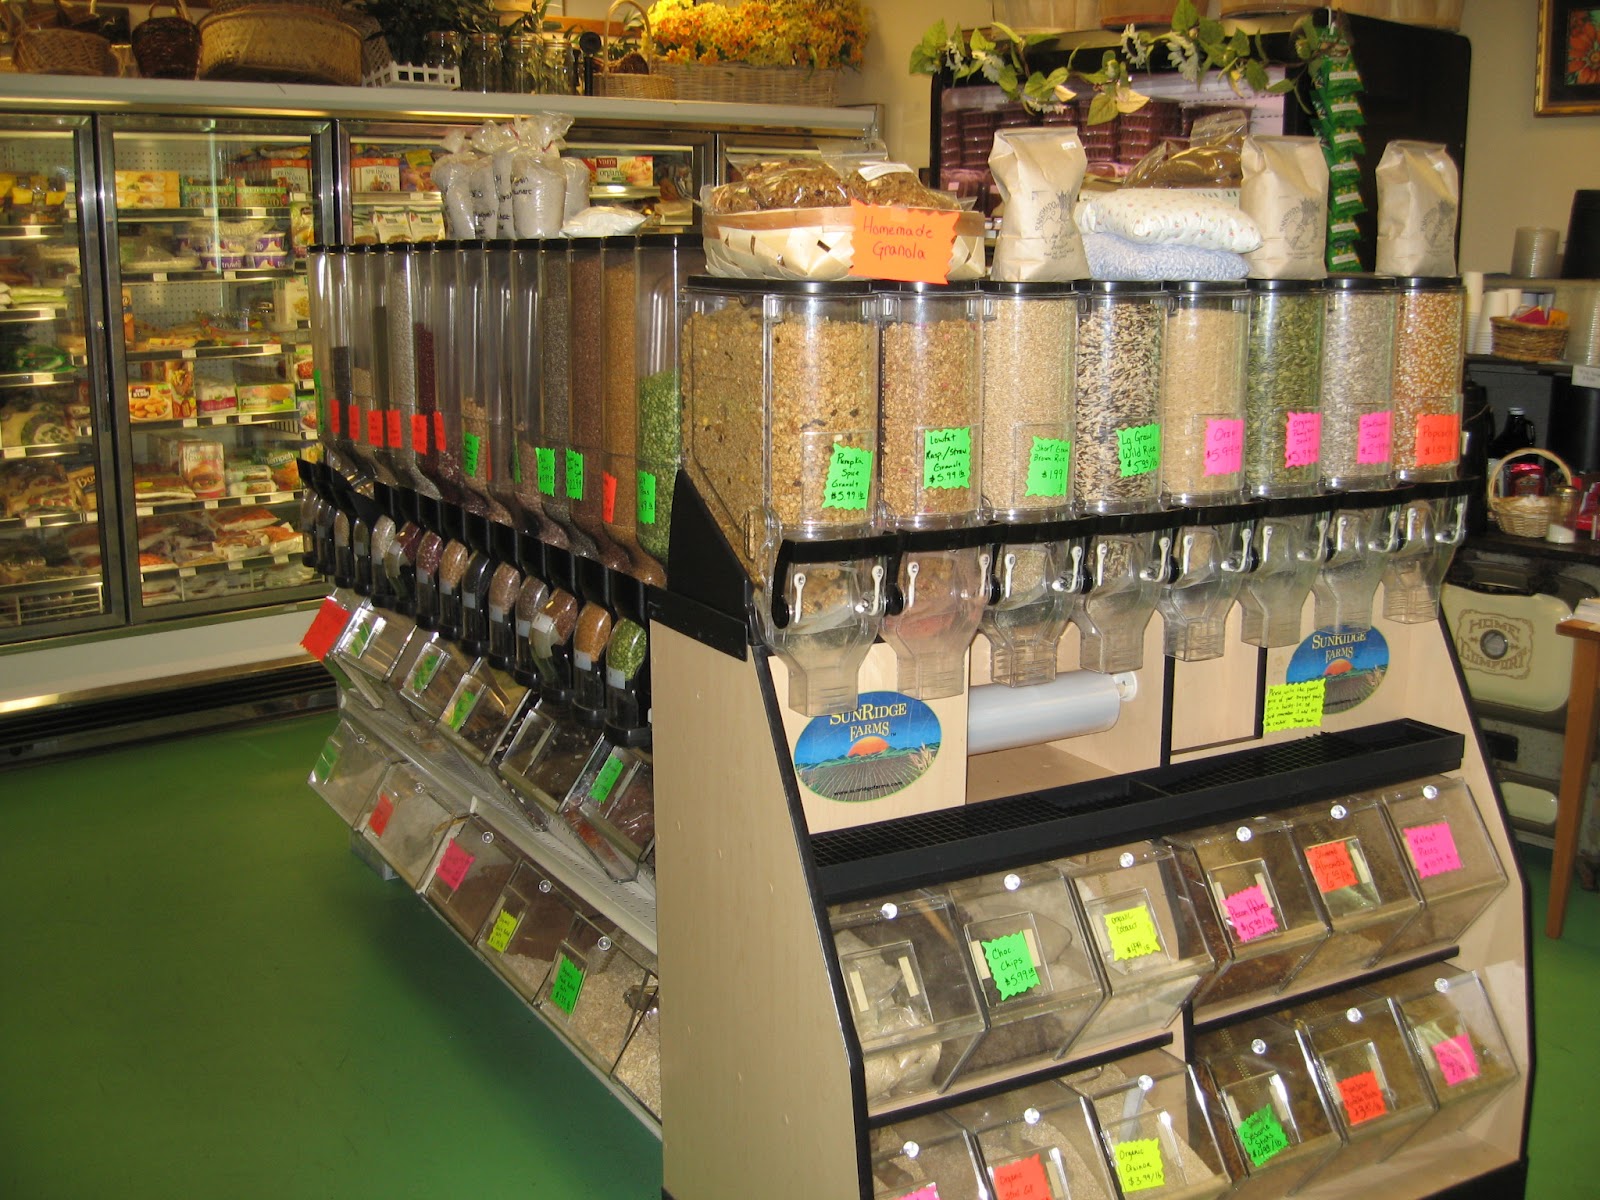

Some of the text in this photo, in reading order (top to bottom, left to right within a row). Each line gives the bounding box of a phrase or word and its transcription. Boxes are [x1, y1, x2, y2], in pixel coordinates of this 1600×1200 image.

[863, 216, 933, 239] Homemade
[873, 241, 926, 261] Granola
[930, 432, 956, 445] Lowfat
[1424, 425, 1452, 441] Popcorn
[1122, 431, 1152, 451] Lg Grain
[1034, 453, 1051, 461] Brown
[1123, 445, 1156, 459] Wild Rice
[842, 469, 859, 479] Spice
[1469, 619, 1520, 642] HOME
[1325, 647, 1354, 664] FARMS
[1460, 637, 1527, 669] COMFORT
[850, 721, 890, 742] FARMS
[833, 781, 903, 796] www.sunridgefarms.com
[1314, 859, 1345, 873] Almonds
[1228, 905, 1249, 922] Pecan
[1001, 957, 1023, 971] Chips
[1244, 1124, 1270, 1145] Sesame
[1255, 1133, 1274, 1148] Sticks
[1119, 1149, 1143, 1161] Organic
[1126, 1162, 1152, 1172] Quinoa
